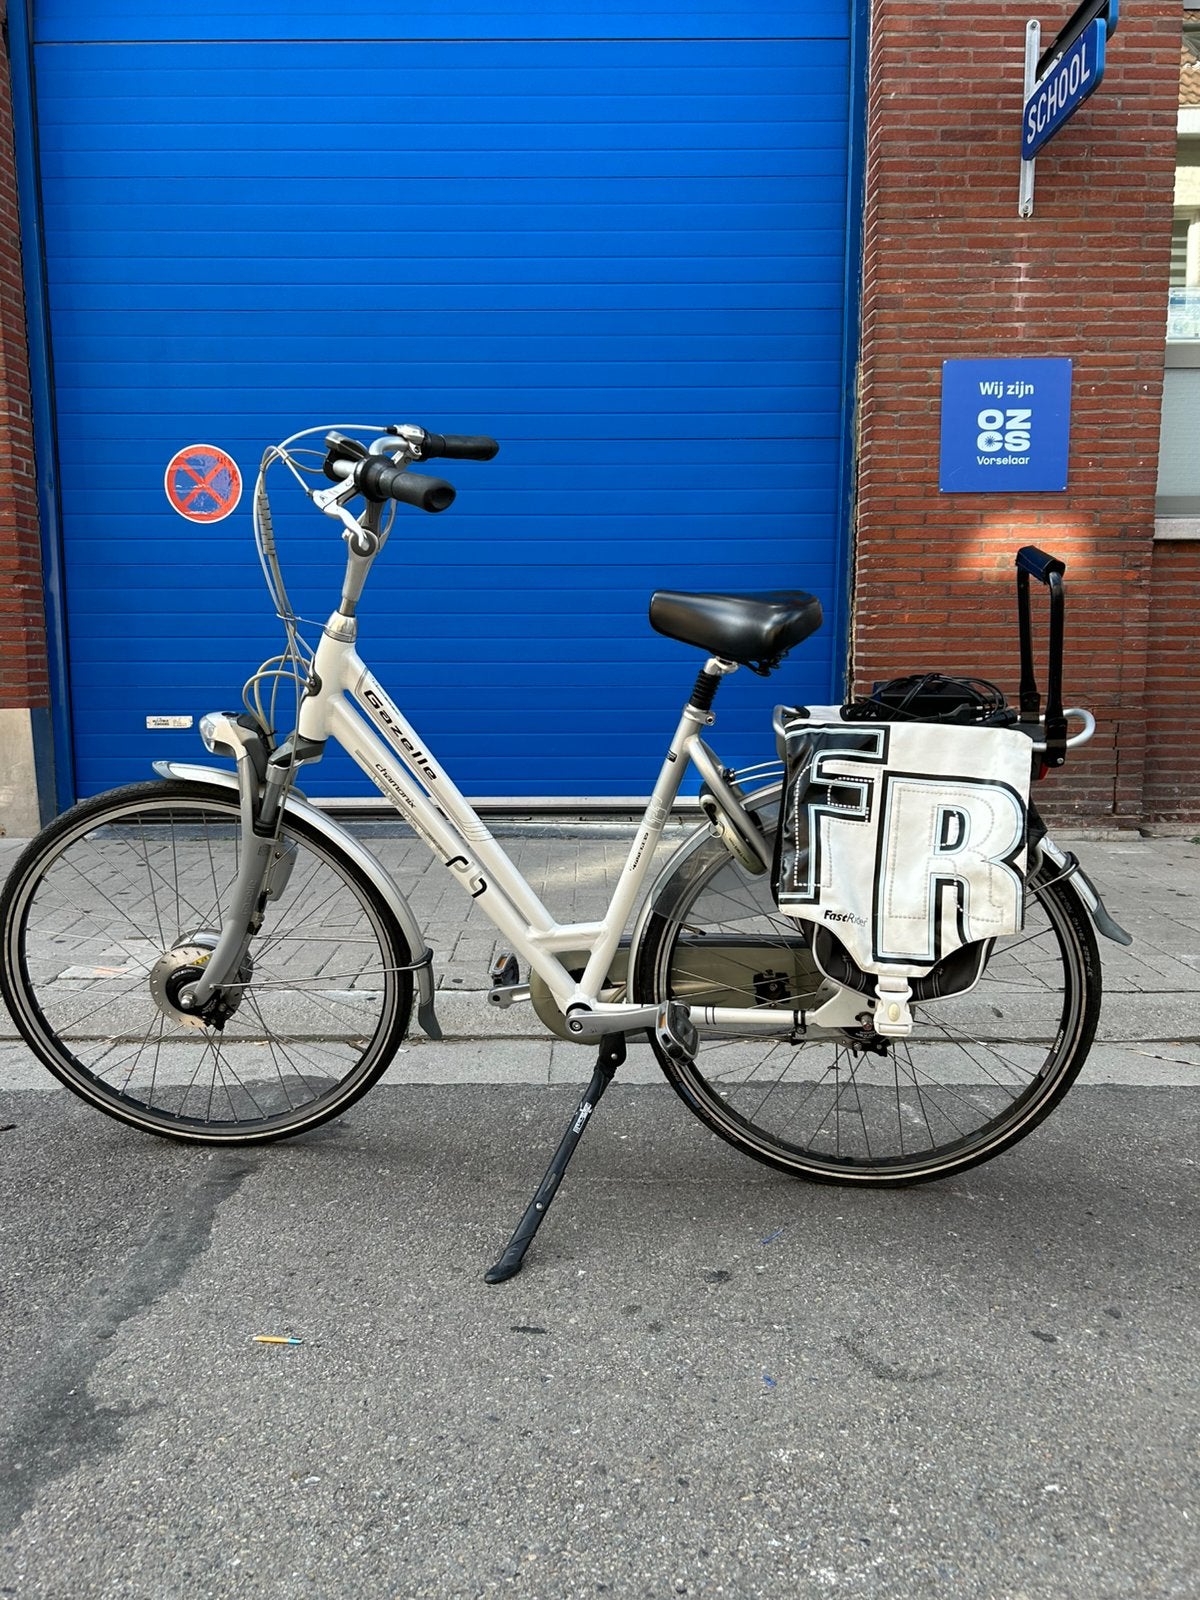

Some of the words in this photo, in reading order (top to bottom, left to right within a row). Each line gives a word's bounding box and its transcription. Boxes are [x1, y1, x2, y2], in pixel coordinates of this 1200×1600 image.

[1026, 42, 1090, 145] SCHOOL
[979, 381, 1004, 399] Wij
[1006, 381, 1035, 399] zijn
[976, 455, 1030, 466] Vorselaar
[363, 689, 438, 781] Gazelle
[375, 763, 417, 809] chamonix
